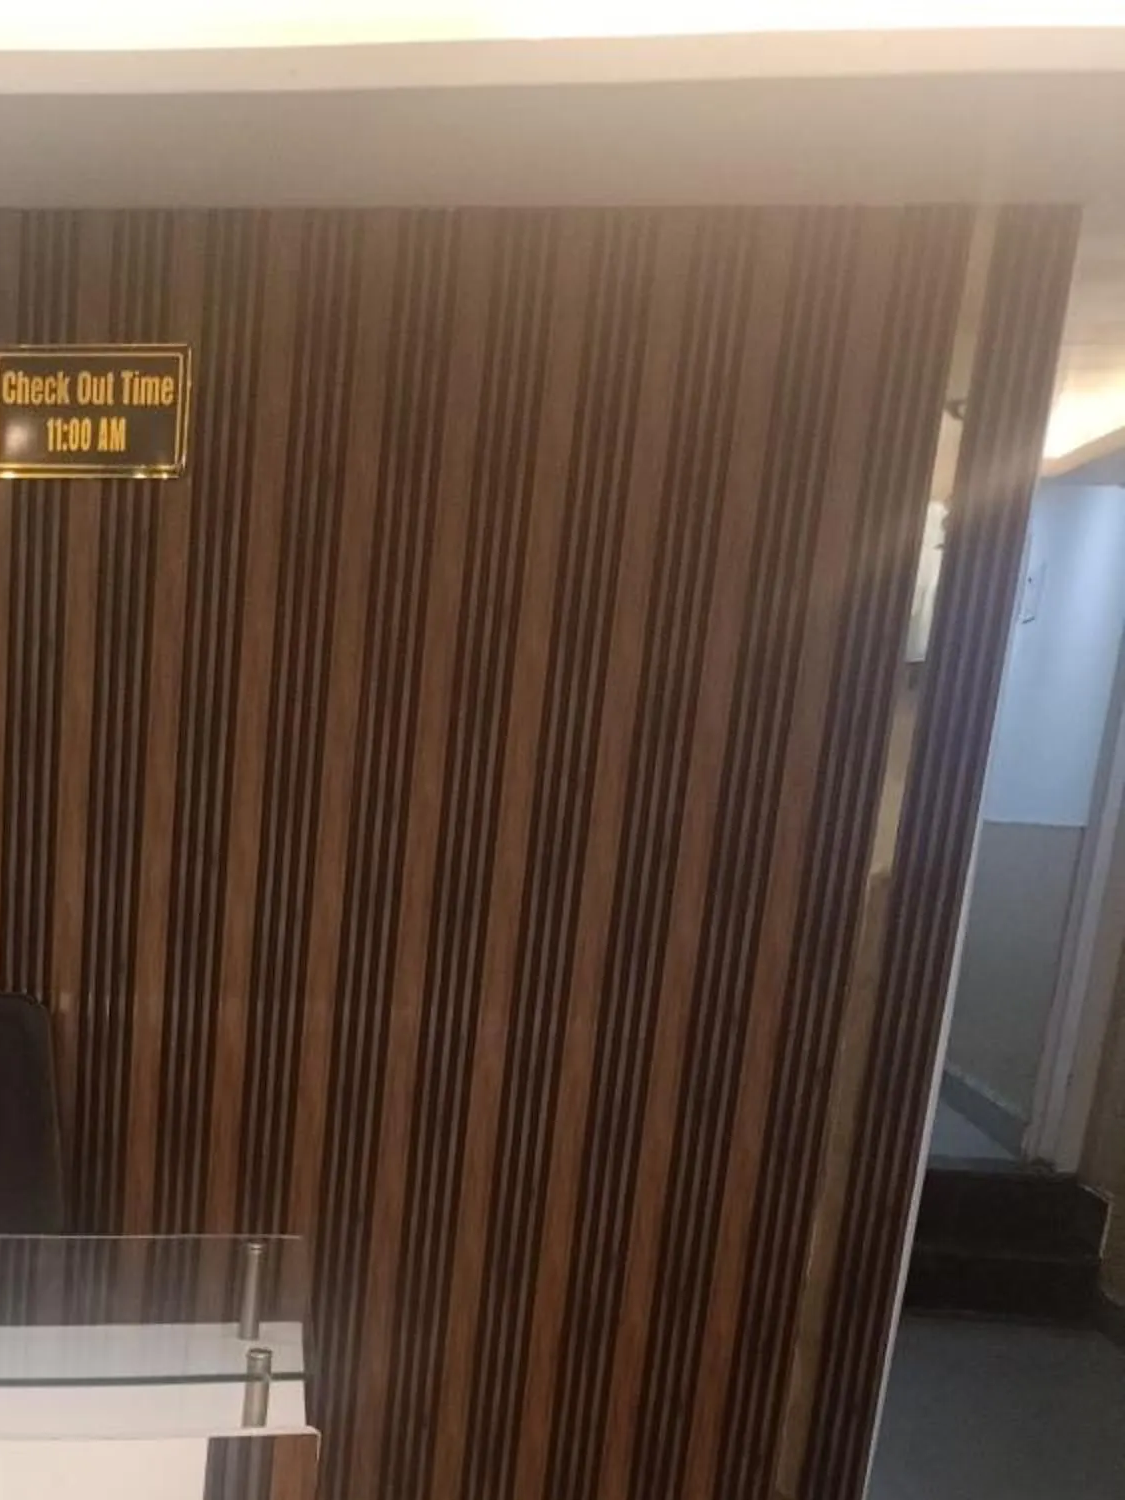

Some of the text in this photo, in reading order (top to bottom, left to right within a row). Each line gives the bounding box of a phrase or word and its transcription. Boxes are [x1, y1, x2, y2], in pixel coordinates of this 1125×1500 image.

[2, 370, 174, 406] Check Out Time
[46, 417, 127, 452] 11:00 AM
